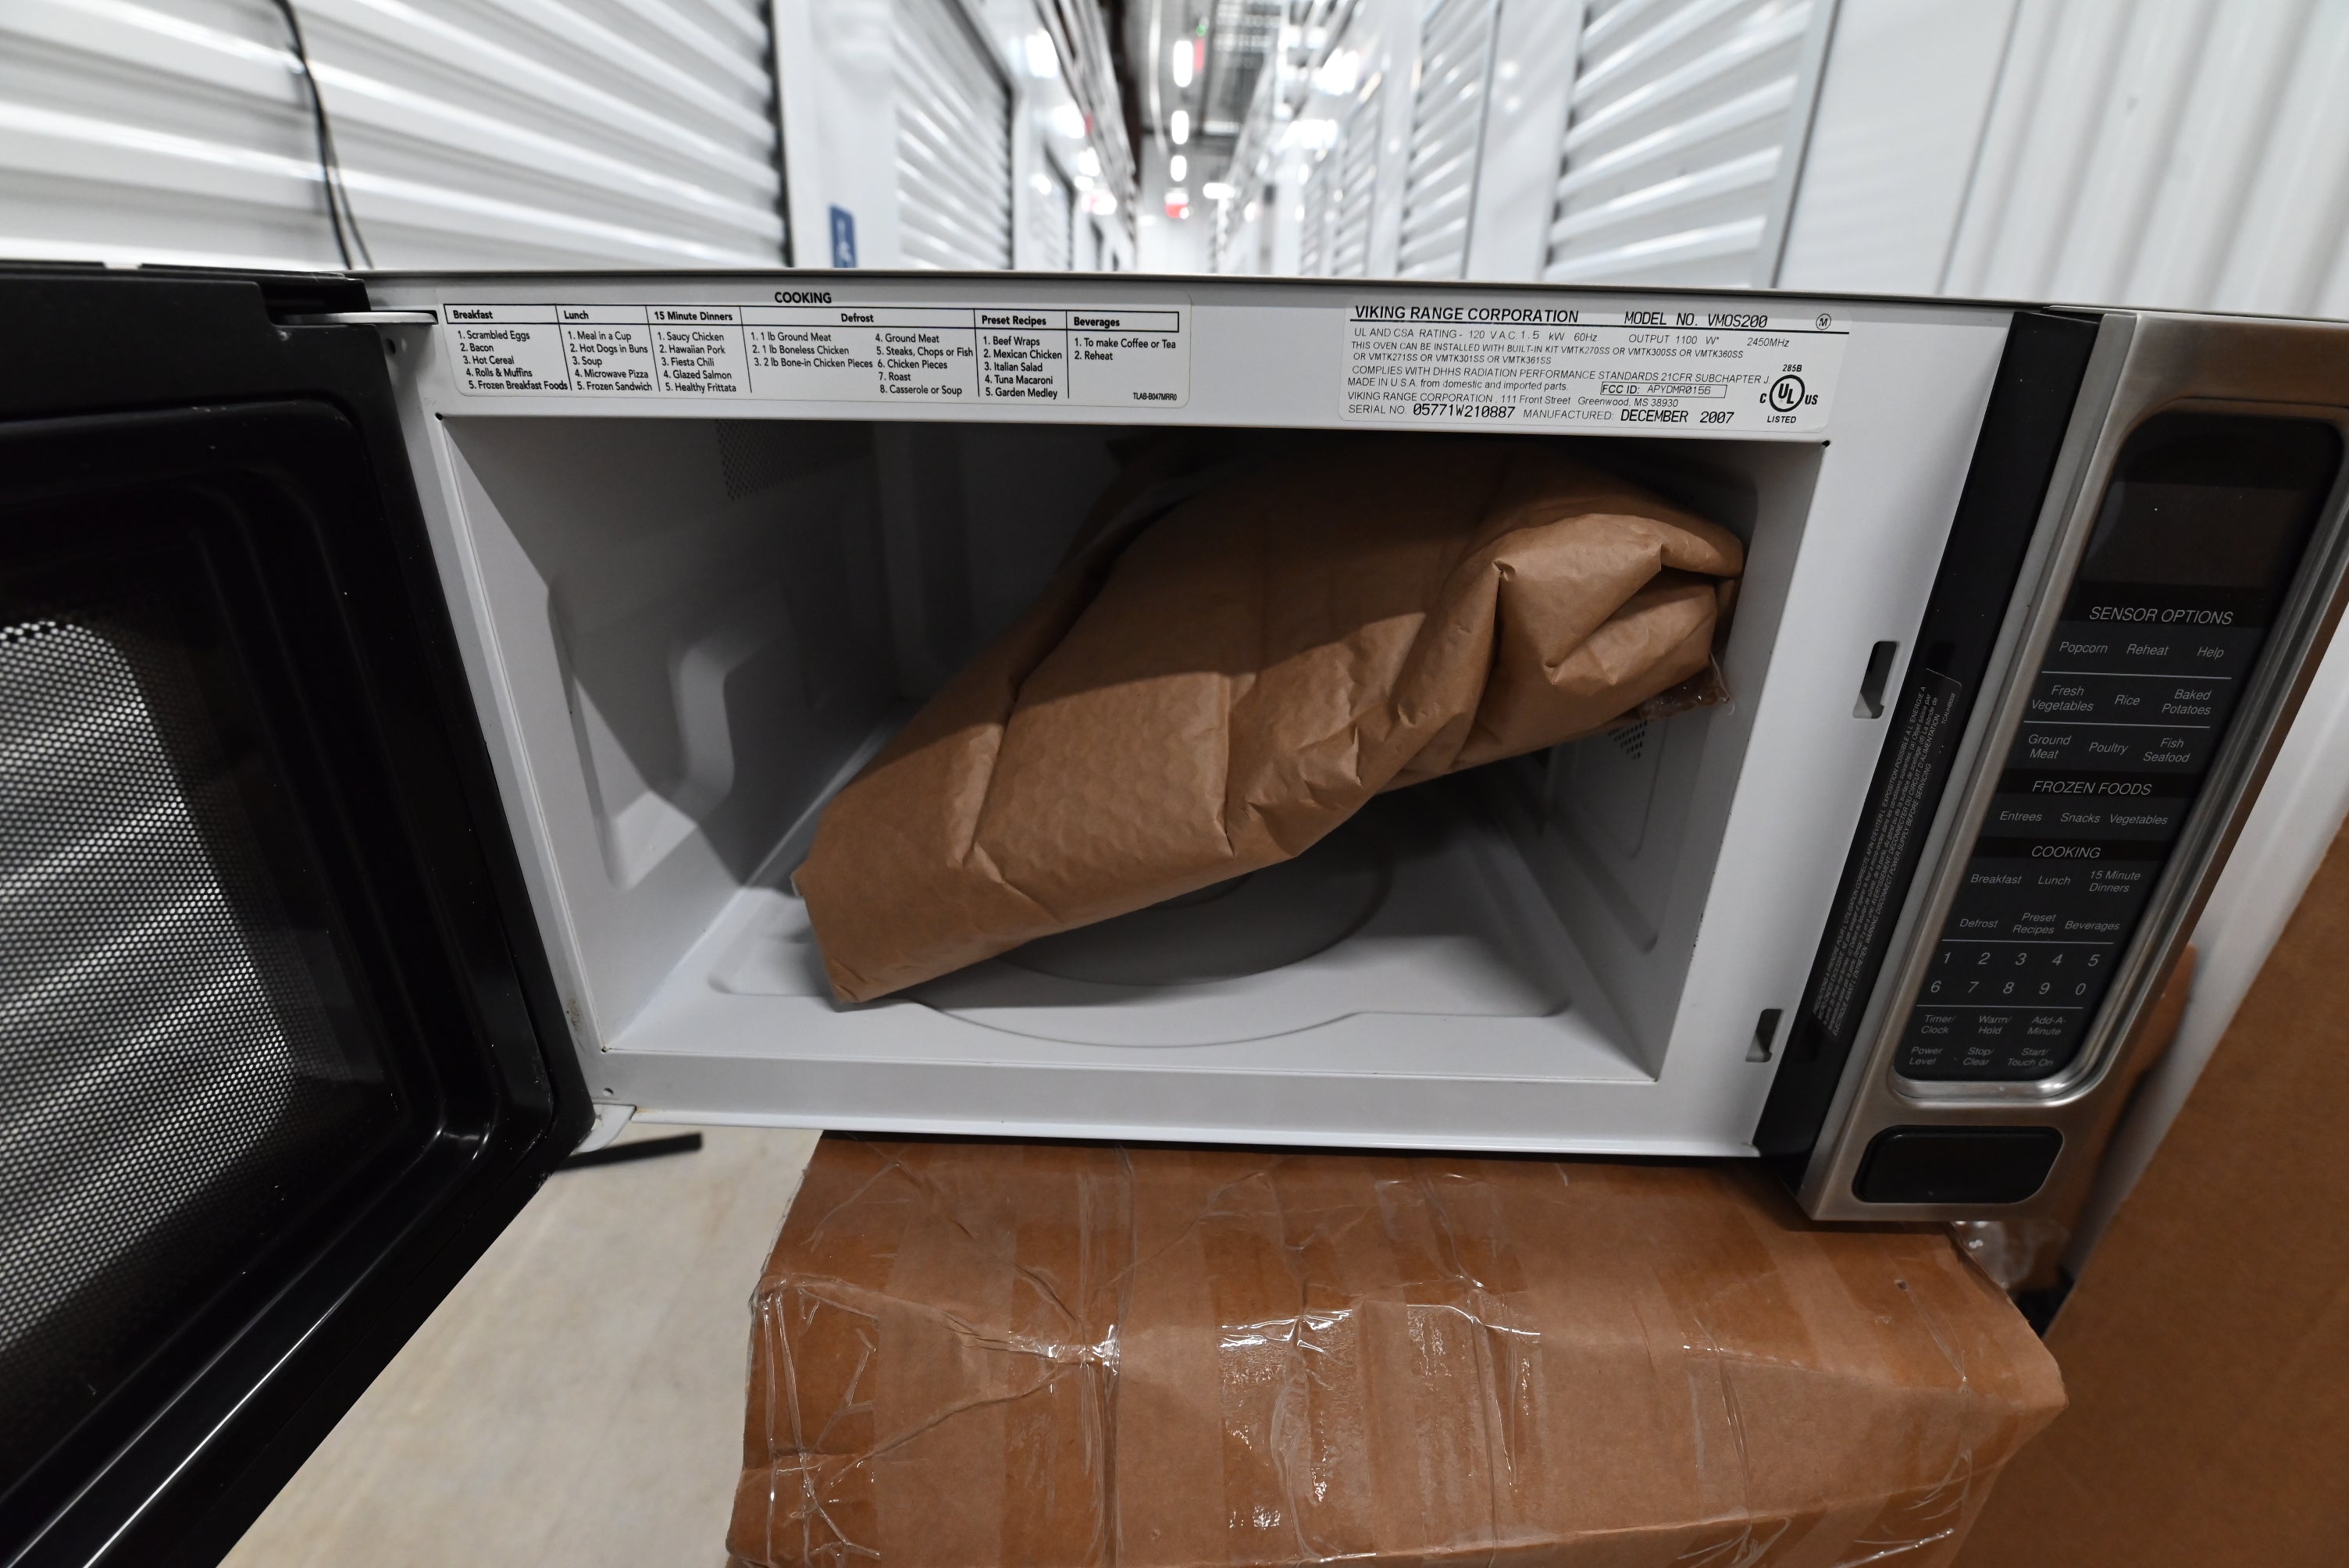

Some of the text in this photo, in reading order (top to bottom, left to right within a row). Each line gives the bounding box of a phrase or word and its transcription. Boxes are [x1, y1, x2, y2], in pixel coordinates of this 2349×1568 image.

[774, 290, 832, 304] COOKING
[452, 308, 494, 319] Breakfast
[563, 309, 589, 319] Lunch
[654, 310, 733, 321] 15 Minute Dinners
[840, 312, 874, 323] Defrost
[1355, 305, 1579, 323] VIKING RANGE CORPORATION
[1624, 312, 1667, 326] MODEL
[982, 315, 1047, 326] Preset Recipes
[1074, 317, 1120, 328] Beverages
[457, 329, 530, 342] 1. Scrambled Eggs
[1628, 333, 1698, 344] OUTPUT 1100
[459, 342, 494, 352] 2. Bacon
[982, 335, 1040, 348] 1. Beef Wraps
[1074, 337, 1082, 347] 1.
[1083, 337, 1094, 347] To
[1096, 337, 1118, 347] make
[1120, 337, 1149, 348] Coffee
[1161, 338, 1176, 349] Tea
[1746, 337, 1790, 347] 2450MHz
[982, 347, 1062, 359] 2. Mexican Chicken
[1351, 340, 1371, 349] THIS
[1372, 341, 1397, 350] OVEN
[1399, 341, 1417, 350] CAN
[1420, 342, 1431, 351] BE
[1434, 342, 1480, 351] INSTALLED
[1506, 344, 1542, 353] BUILT-IN
[1612, 347, 1625, 355] OR
[1627, 347, 1677, 356] VMTK300SS
[1679, 348, 1692, 357] OR
[1695, 349, 1744, 358] VMTK360SS
[462, 355, 515, 365] 3. Hot Cereal
[1074, 350, 1113, 361] 2. Reheat
[1353, 352, 1551, 365] OR VMTK271SS OR VMTK301SS OR VMTK361SS
[465, 367, 533, 377] 4. Rolls & Muffins
[984, 361, 1043, 372] 3. Italian Salad
[1781, 363, 1802, 372] 285B
[984, 373, 1053, 385] 4. Tuna Macaroni
[1352, 365, 1403, 375] COMPLIES
[1405, 365, 1431, 376] WITH
[1432, 366, 1461, 376] DHHS
[1463, 367, 1517, 377] RADIATION
[1519, 369, 1596, 380] PERFORMANCE
[1598, 370, 1659, 383] STANDARDS
[1660, 372, 1693, 384] 21CFR
[1695, 372, 1762, 385] SUBCHAPTER
[468, 380, 569, 390] 5. Frozen Breakfast Foods
[1602, 384, 1623, 394] FCC
[1627, 385, 1640, 394] ID:
[985, 387, 1057, 400] 5. Garden Medley
[1805, 394, 1818, 405] US
[1348, 404, 1385, 414] SERIAL
[1620, 408, 1688, 422] DECEMBER
[1699, 411, 1734, 423] 2007
[1766, 415, 1797, 423] LISTED
[2089, 606, 2233, 625] SENSOR OPTIONS
[2058, 641, 2108, 655] Popcorn
[2126, 643, 2169, 656] Reheat
[2196, 646, 2224, 660] Help
[2051, 684, 2084, 696] Fresh
[2173, 688, 2212, 700] Baked
[2032, 699, 2094, 712] Vegetables
[2114, 694, 2140, 706] Rice
[2161, 703, 2212, 715] Potatoes
[2028, 733, 2072, 745] Ground
[2159, 737, 2184, 748] Fish
[2029, 748, 2058, 759] Meat
[2088, 741, 2129, 755] Poultry
[2142, 750, 2190, 763] Seafood
[2031, 780, 2152, 796] FROZEN FOODS
[1999, 811, 2042, 821] Entrees
[2060, 812, 2101, 823] Snacks
[2110, 813, 2168, 826] Vegetables
[2031, 845, 2101, 858] COOKING
[1969, 873, 2022, 884] Breakfast
[2037, 875, 2071, 885] Lunch
[2090, 870, 2141, 880] 15 Minute
[2088, 882, 2130, 893] Dinners
[2021, 912, 2056, 922] Preset
[1959, 918, 1998, 928] Defrost
[2064, 920, 2120, 932] Beverages
[2012, 924, 2055, 935] Recipes
[1944, 951, 2101, 967] 1 2 3 4 5
[1930, 980, 2087, 996] 6 7 8 9 0
[1924, 1014, 1956, 1023] Timer/
[1978, 1014, 2012, 1024] Warm/
[1920, 1025, 1949, 1034] Clock
[1977, 1025, 2002, 1035] Hold
[2026, 1026, 2062, 1035] Minute
[1910, 1046, 1943, 1054] Power
[1968, 1046, 1994, 1057] Stop/
[2022, 1048, 2049, 1057] Start/
[1909, 1057, 1937, 1065] Level
[2008, 1058, 2036, 1067] Touch
